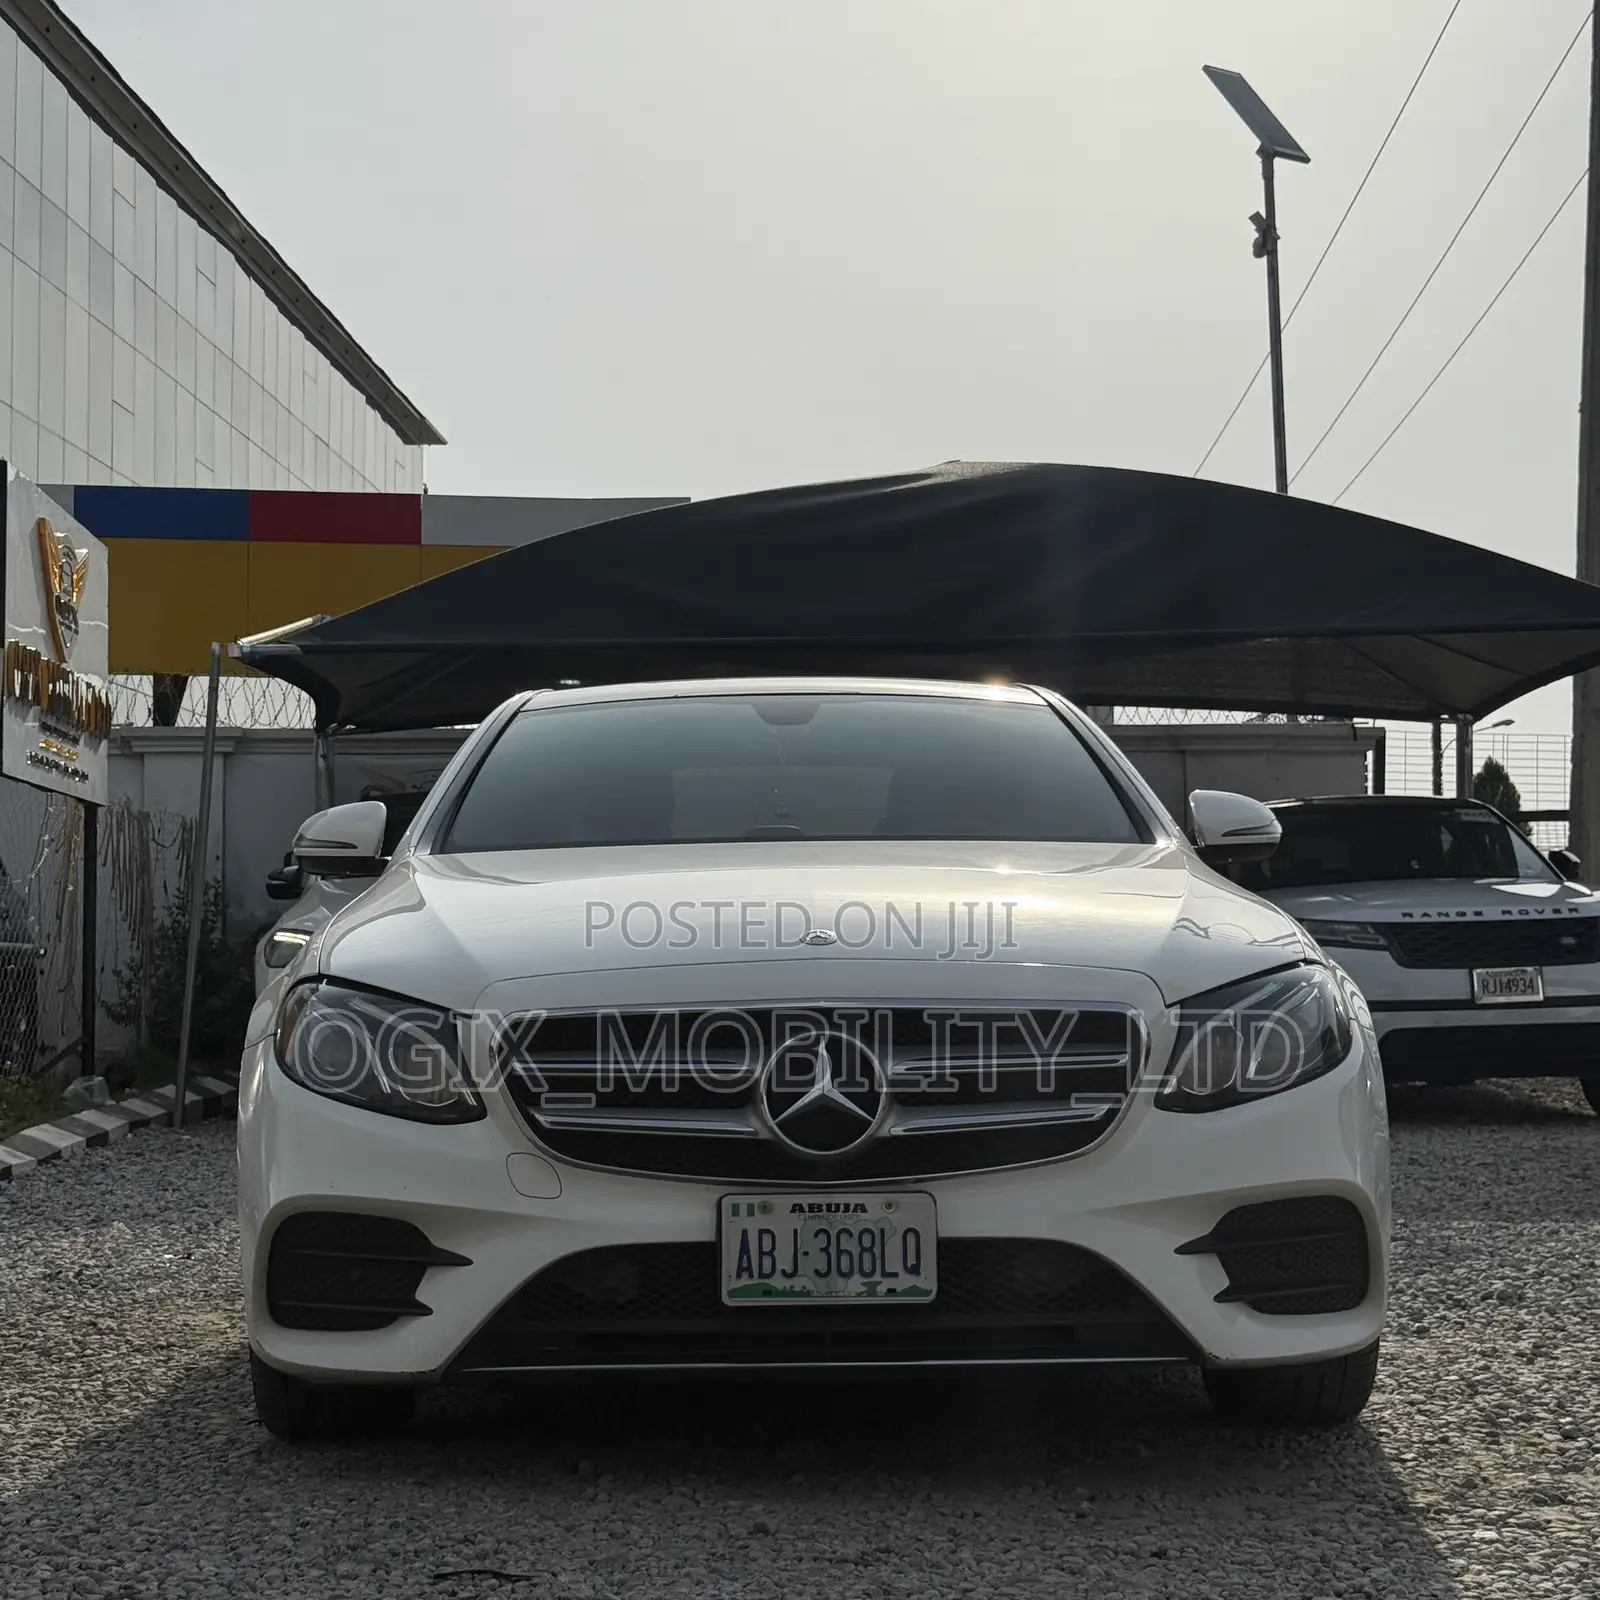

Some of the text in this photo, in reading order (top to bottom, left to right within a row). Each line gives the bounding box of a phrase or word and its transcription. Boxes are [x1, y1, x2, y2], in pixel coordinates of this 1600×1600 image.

[1401, 907, 1580, 919] RANGE ROVER
[789, 1202, 869, 1214] ABUJA
[735, 1227, 922, 1279] ABJ-368LQ
